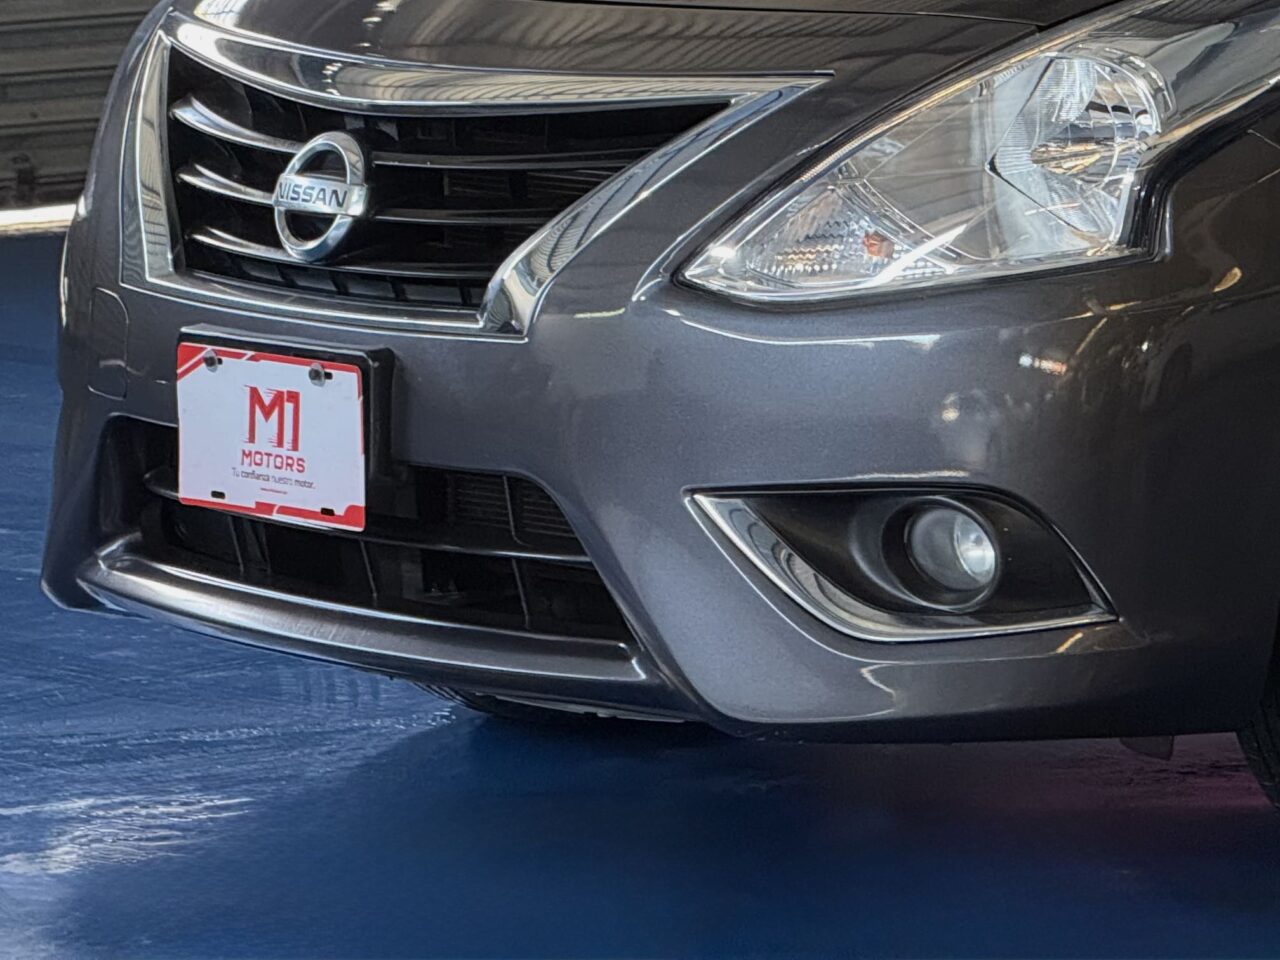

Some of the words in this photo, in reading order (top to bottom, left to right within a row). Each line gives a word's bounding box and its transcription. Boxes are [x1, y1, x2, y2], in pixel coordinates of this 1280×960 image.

[278, 182, 348, 208] NISSAN
[246, 385, 301, 452] M1
[240, 449, 306, 473] MOTORS
